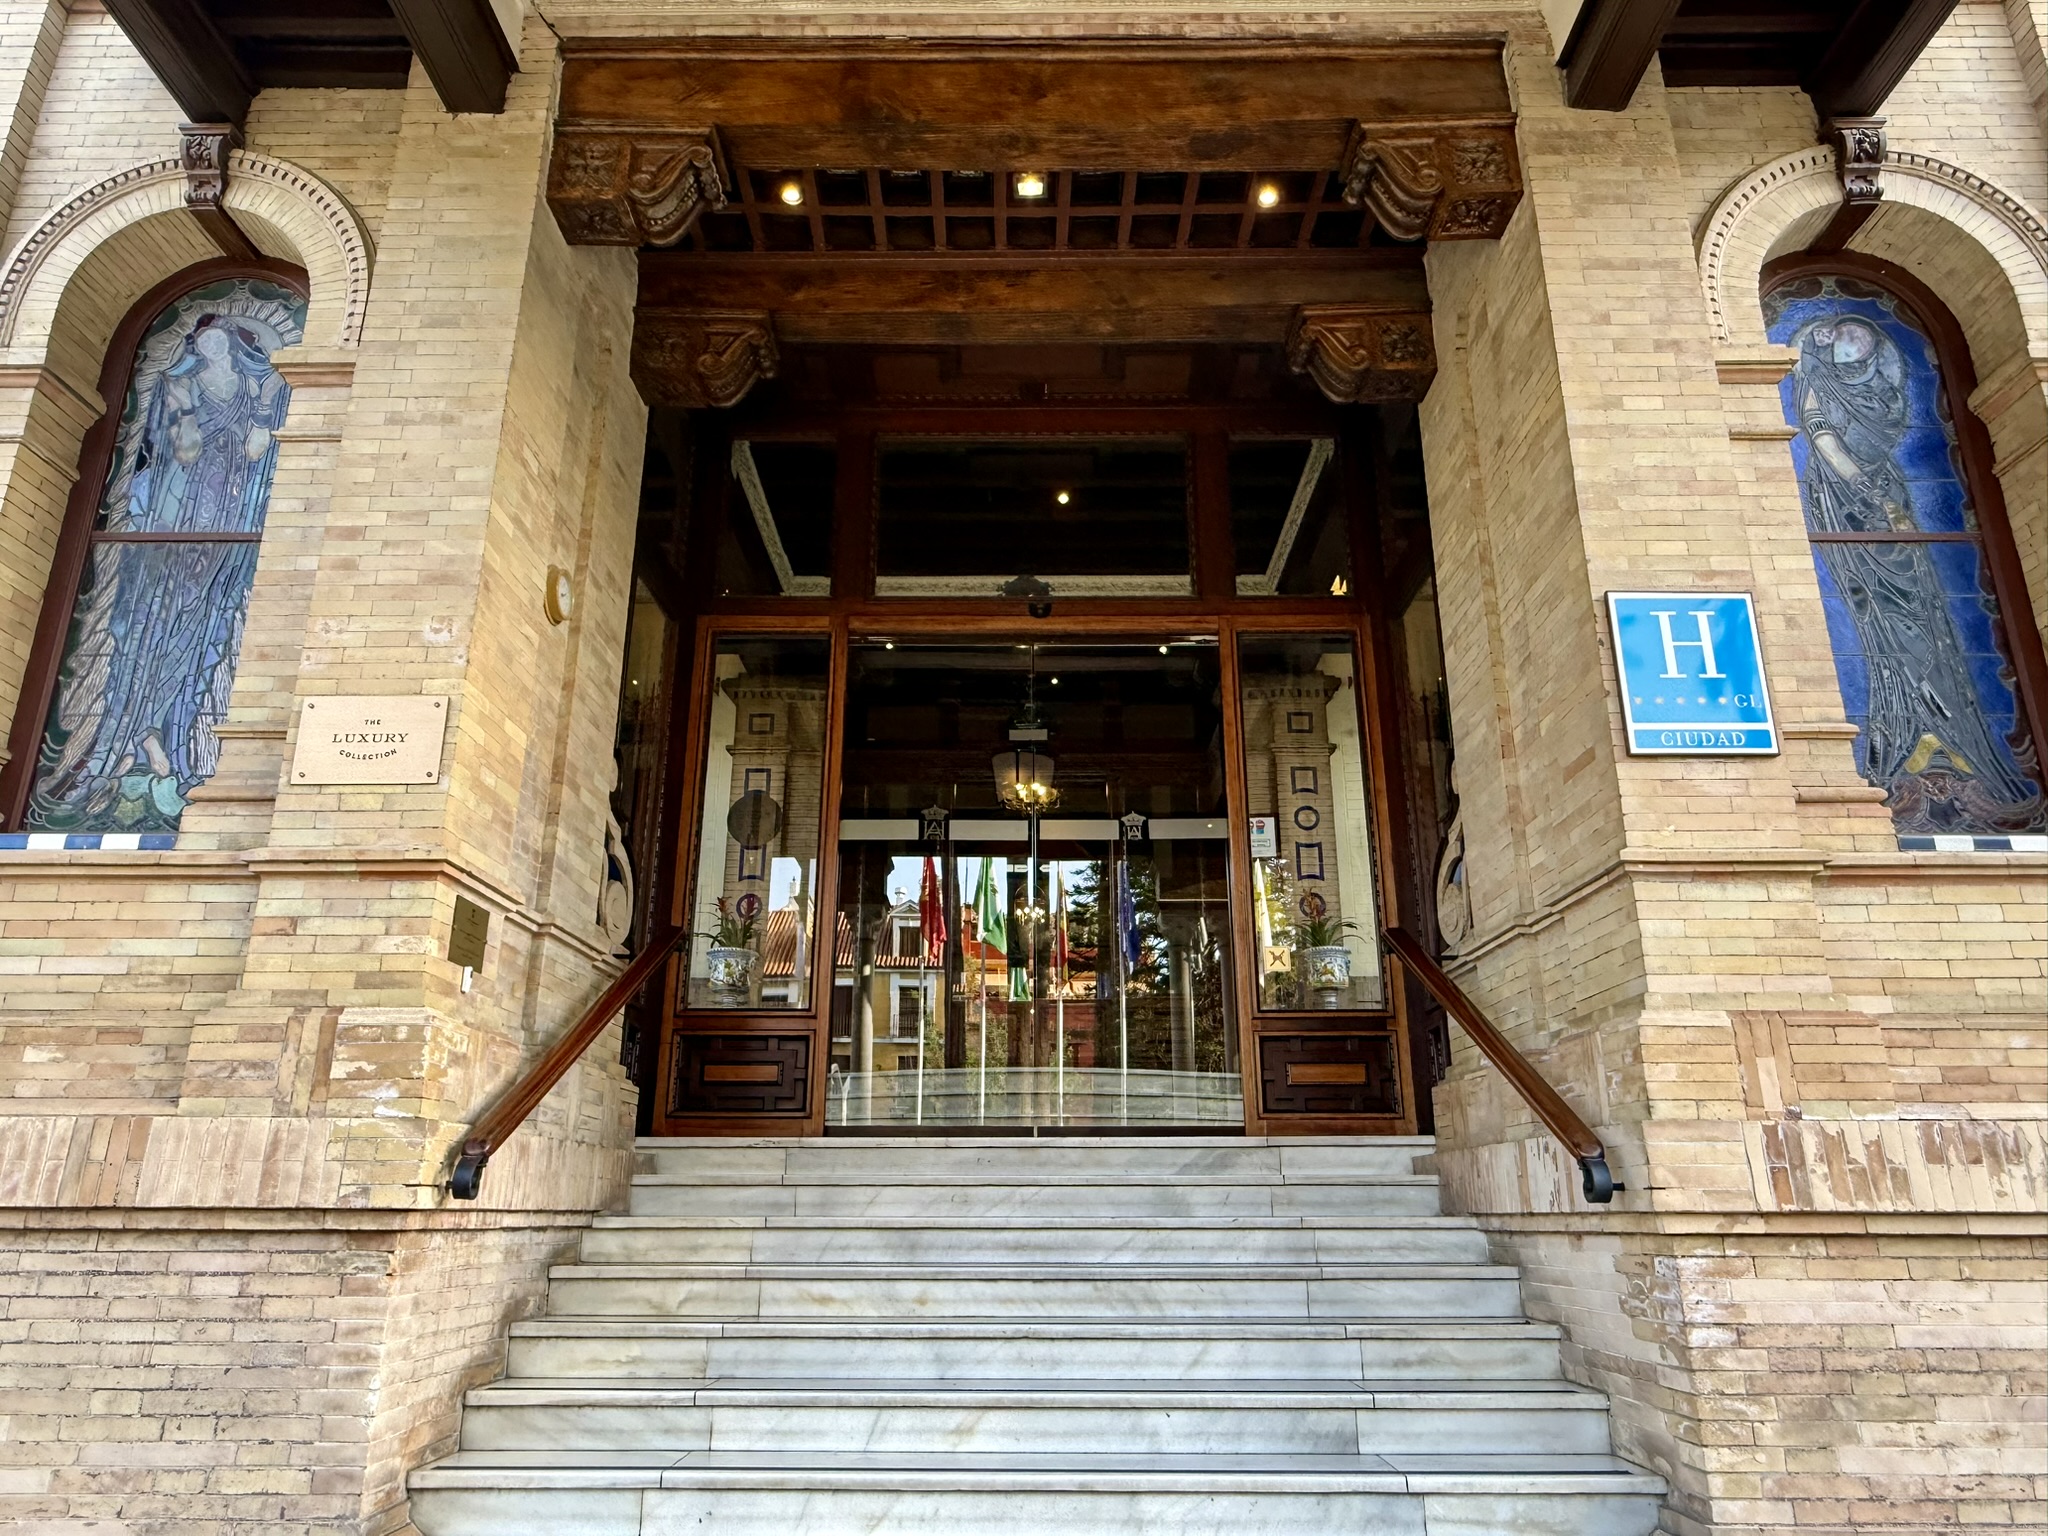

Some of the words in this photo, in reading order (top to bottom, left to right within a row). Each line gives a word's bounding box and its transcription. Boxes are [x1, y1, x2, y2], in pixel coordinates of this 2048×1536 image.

[1649, 611, 1727, 679] H
[331, 732, 409, 744] LUXURY
[1660, 731, 1746, 746] CIUDAD
[339, 748, 398, 760] COLLECTION
